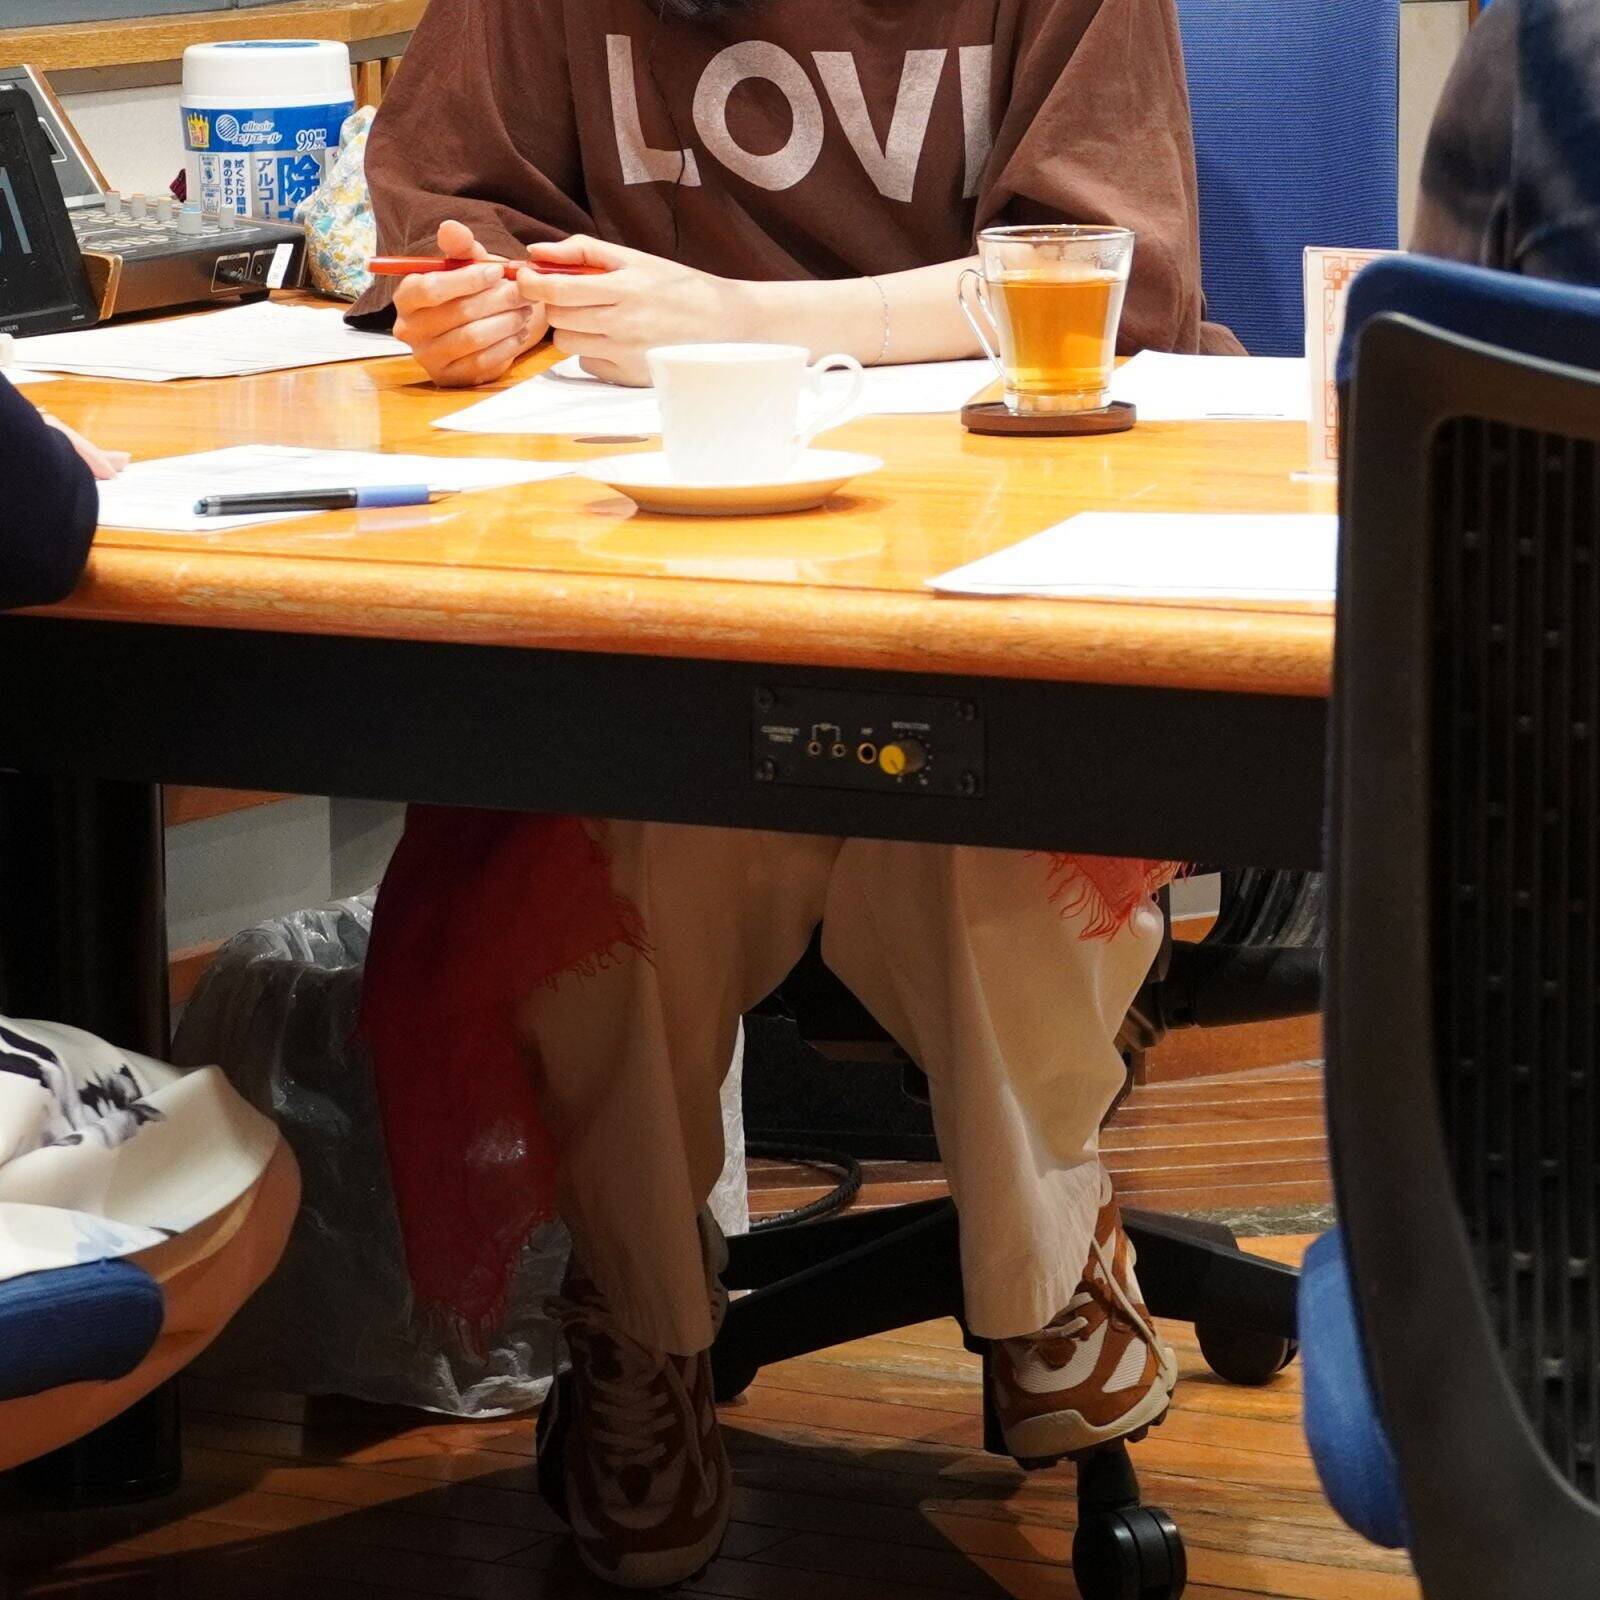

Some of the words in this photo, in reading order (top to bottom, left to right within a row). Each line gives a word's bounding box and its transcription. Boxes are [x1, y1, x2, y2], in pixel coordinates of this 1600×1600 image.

[257, 158, 274, 219] アルコー
[277, 154, 320, 224] 除
